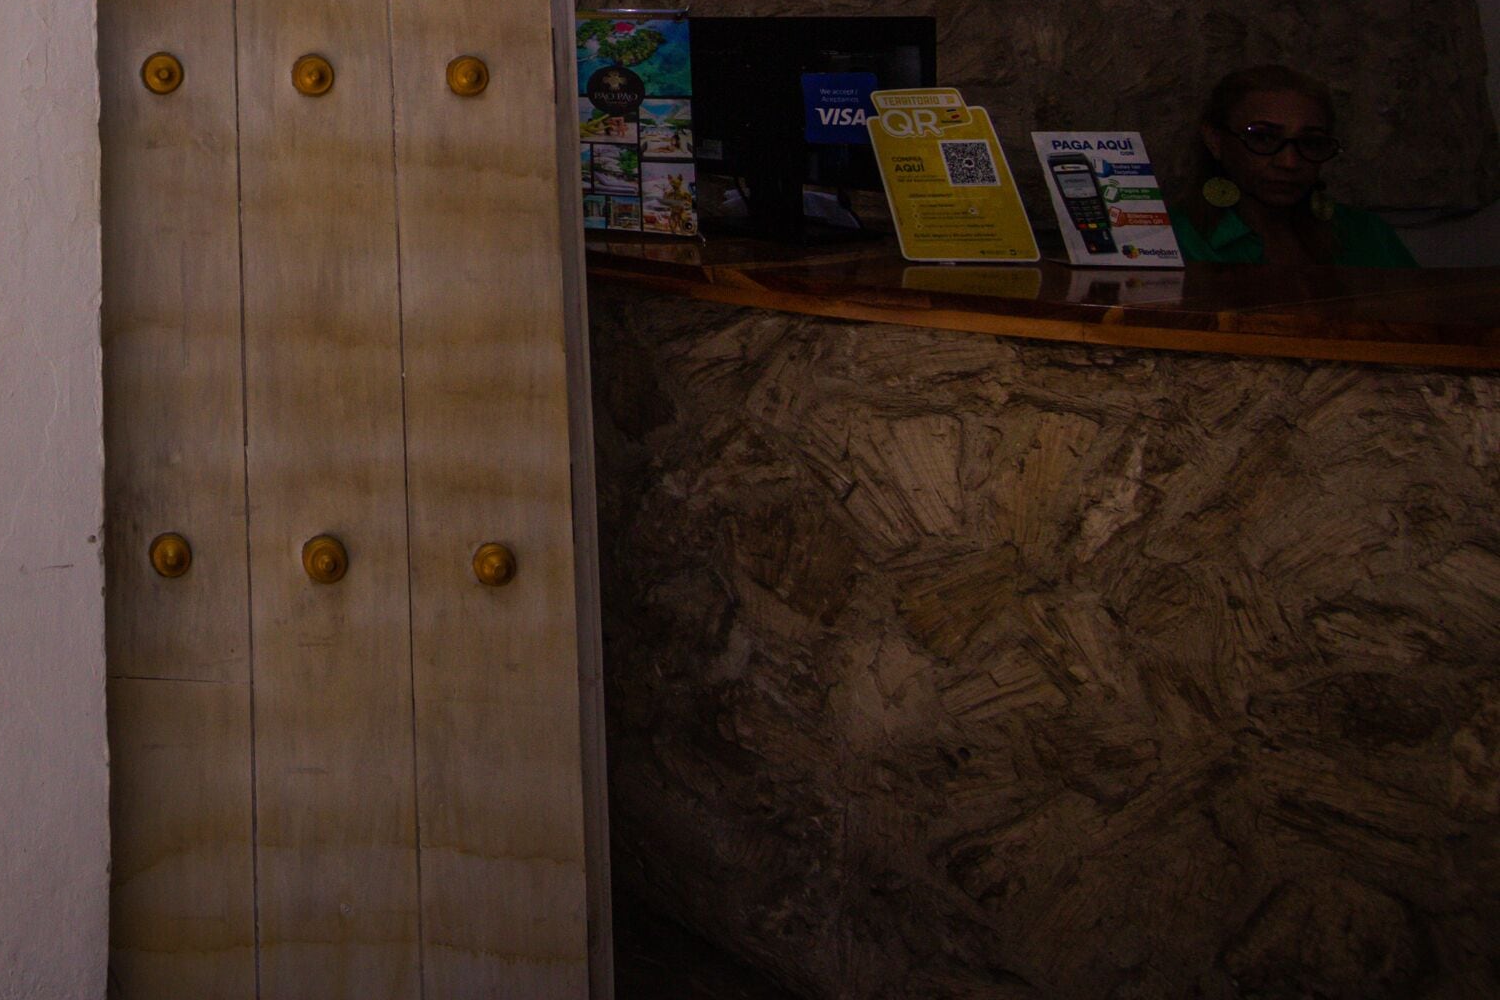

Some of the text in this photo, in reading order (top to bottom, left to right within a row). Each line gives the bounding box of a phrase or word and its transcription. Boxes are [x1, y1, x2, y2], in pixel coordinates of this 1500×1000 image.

[883, 95, 940, 105] TERRITORIO
[814, 107, 867, 126] VISA
[881, 108, 943, 137] QR
[1052, 137, 1133, 151] PAGA AQUÍ
